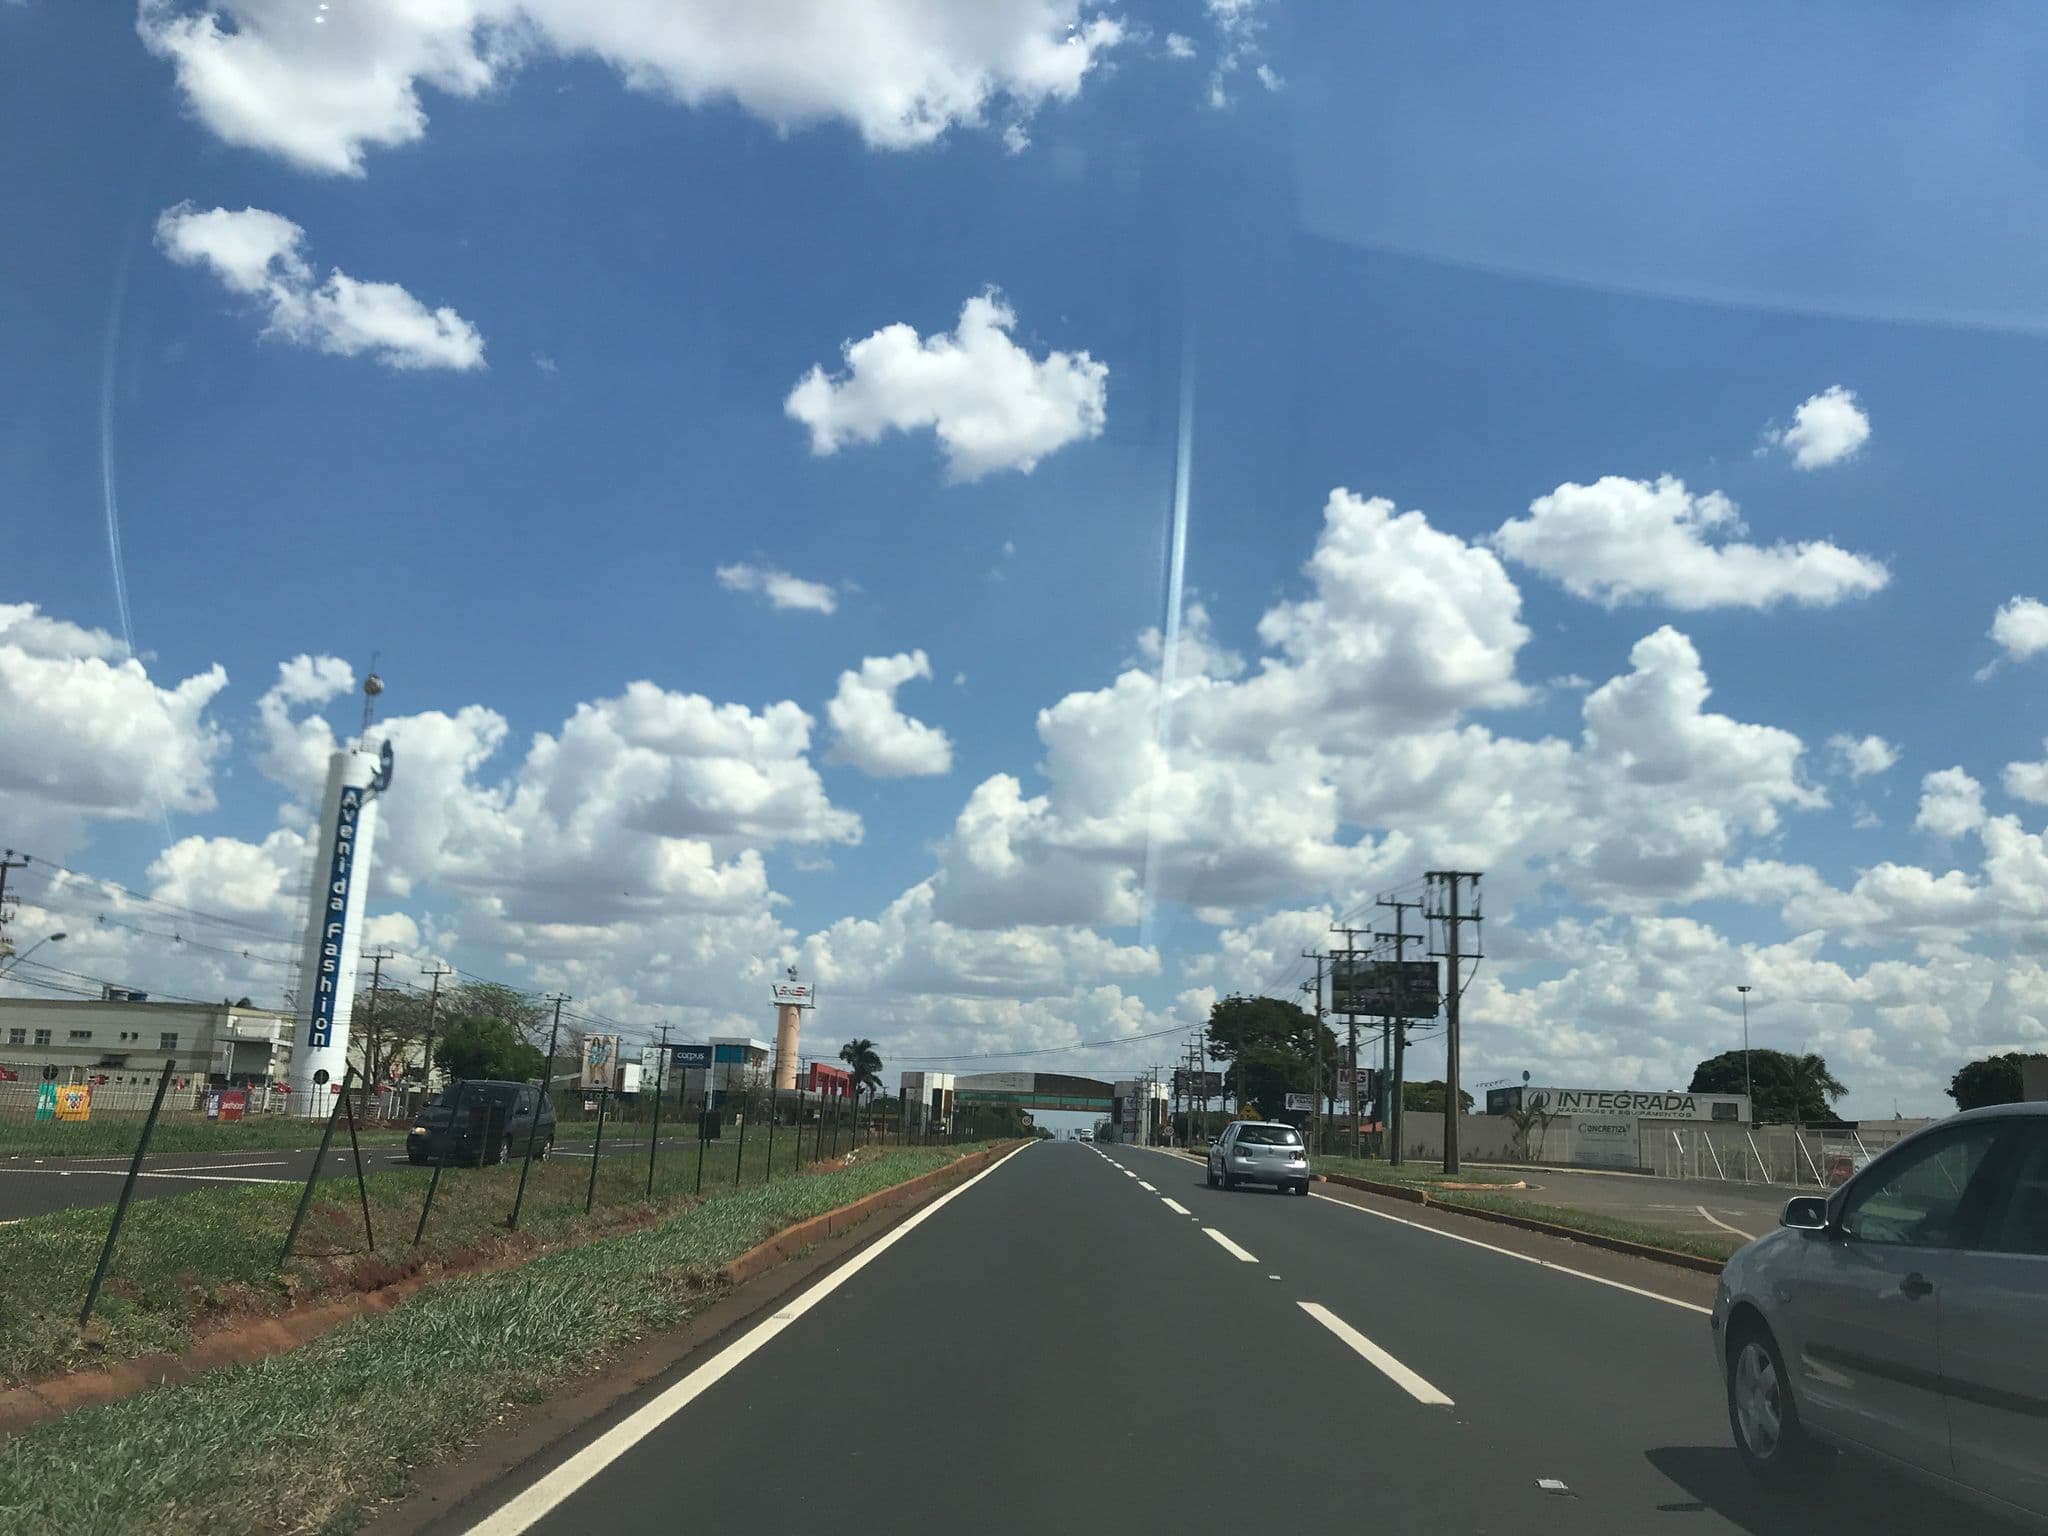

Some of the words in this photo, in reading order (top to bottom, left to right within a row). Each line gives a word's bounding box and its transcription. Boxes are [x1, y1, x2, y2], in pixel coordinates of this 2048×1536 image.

[329, 790, 359, 911] Avenida
[677, 1051, 705, 1061] corpus
[1557, 1091, 1697, 1112] INTEGRADA
[1618, 1109, 1692, 1118] EQUIPAMENTOS
